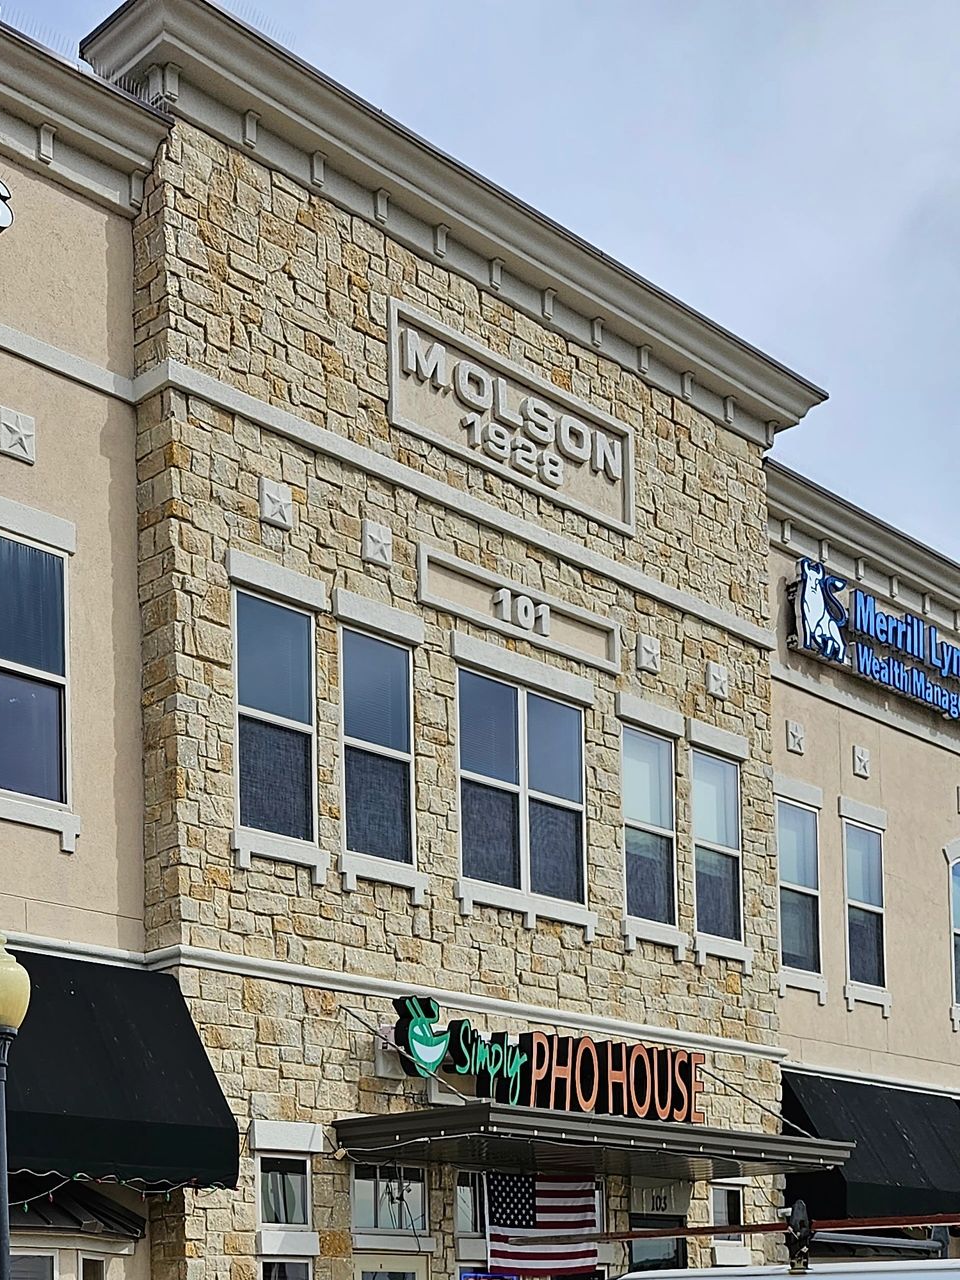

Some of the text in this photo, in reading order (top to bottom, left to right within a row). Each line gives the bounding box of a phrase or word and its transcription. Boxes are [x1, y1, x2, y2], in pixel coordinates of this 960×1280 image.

[461, 411, 564, 488] 1928
[494, 588, 551, 637] 101
[854, 588, 925, 661] Merrill
[856, 642, 960, 719] Wealth Manag
[454, 1018, 706, 1123] Simply PHO HOUSE
[651, 1195, 667, 1212] 103
